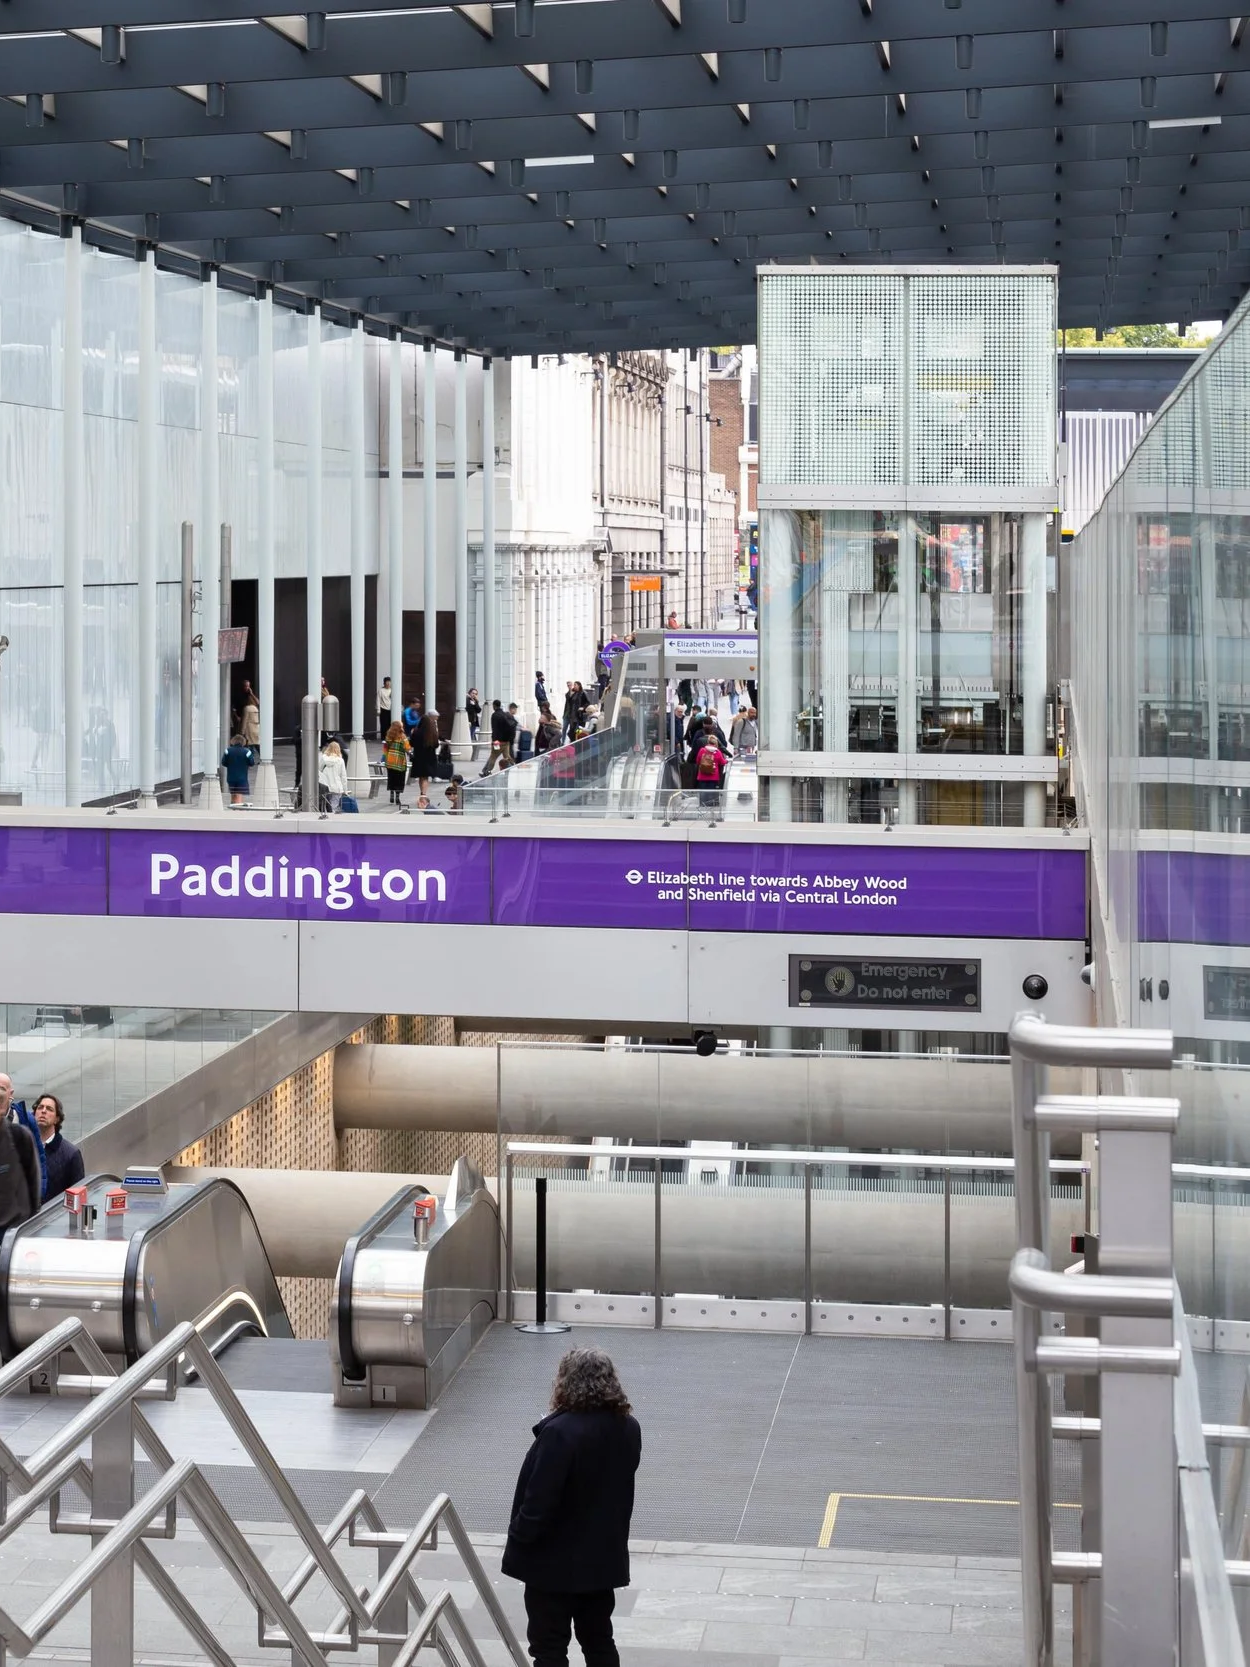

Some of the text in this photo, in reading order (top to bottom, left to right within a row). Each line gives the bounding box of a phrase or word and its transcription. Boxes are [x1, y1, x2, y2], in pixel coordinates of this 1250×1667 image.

[677, 640, 726, 648] Elizabeth line
[150, 853, 447, 910] Paddington
[647, 871, 908, 891] Elizabeth line towards Abbey Wood
[657, 888, 897, 905] and Shenfield via Central London
[861, 962, 948, 981] Emergency
[857, 984, 952, 1000] Do not enter
[40, 1372, 49, 1386] 2
